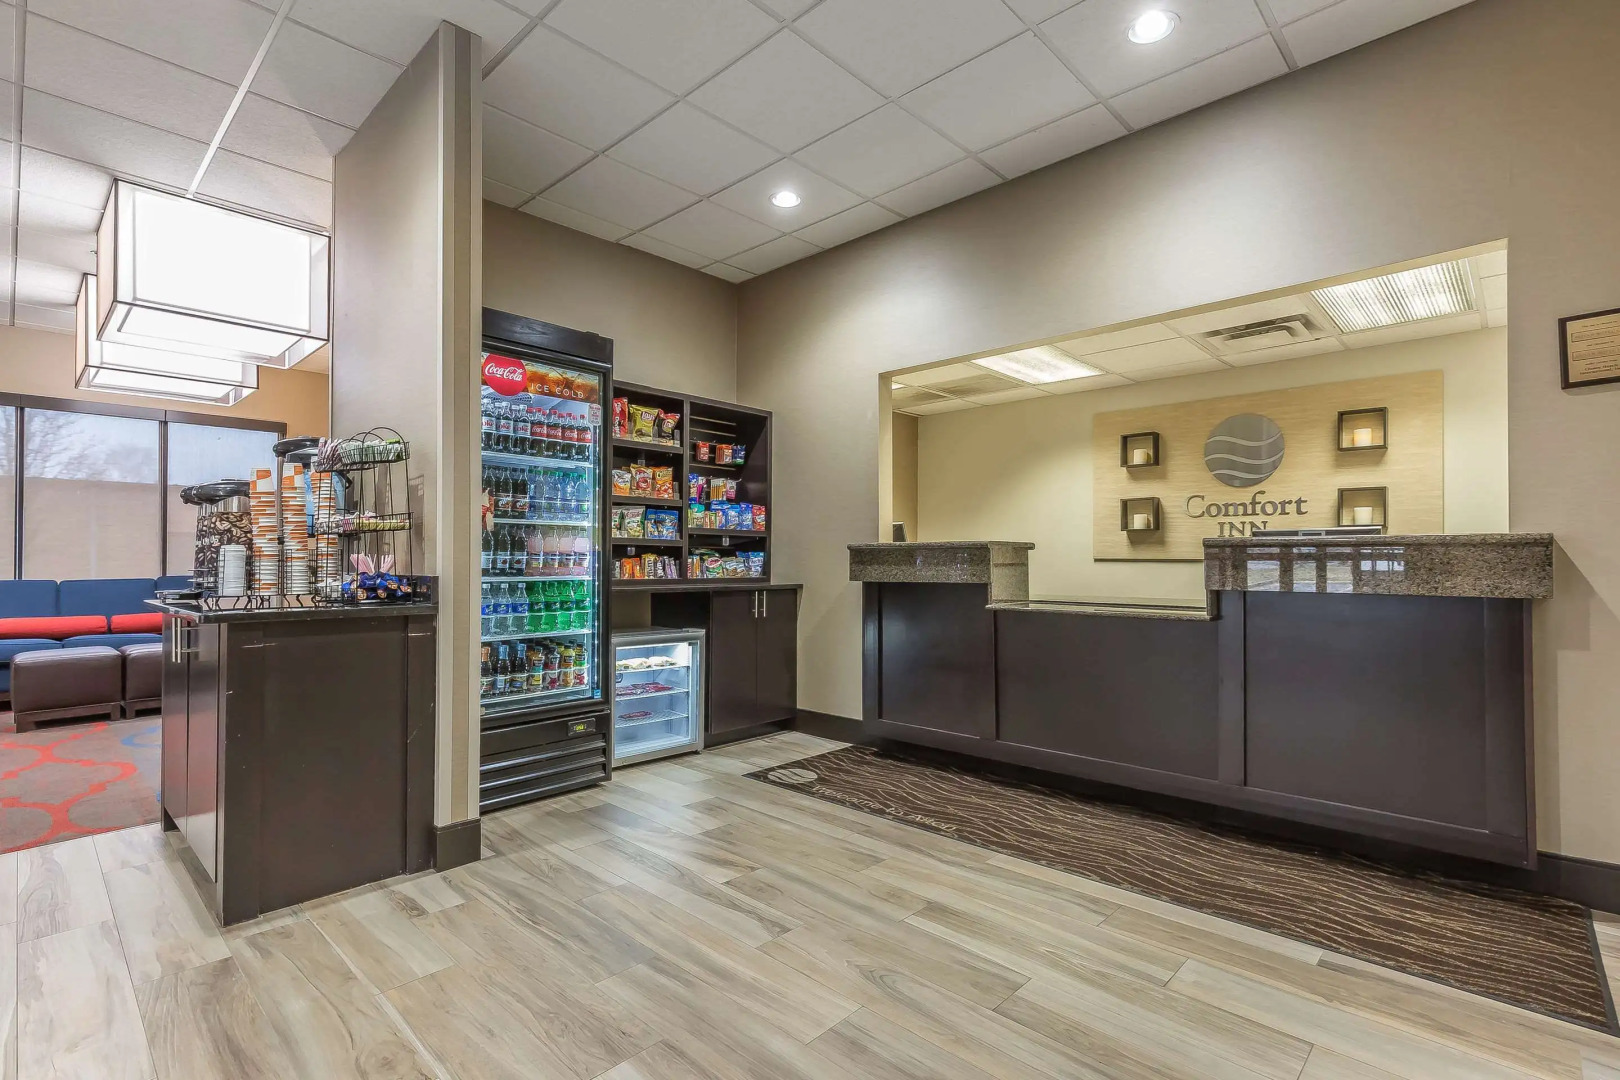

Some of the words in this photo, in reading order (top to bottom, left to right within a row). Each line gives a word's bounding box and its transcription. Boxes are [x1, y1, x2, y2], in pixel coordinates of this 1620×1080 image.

[484, 362, 524, 382] Coca-Cola
[530, 382, 550, 393] ICE
[555, 387, 585, 399] COLD
[1185, 490, 1309, 519] Comfort
[1217, 520, 1269, 538] INN
[812, 785, 883, 809] Welcome
[886, 806, 905, 816] to
